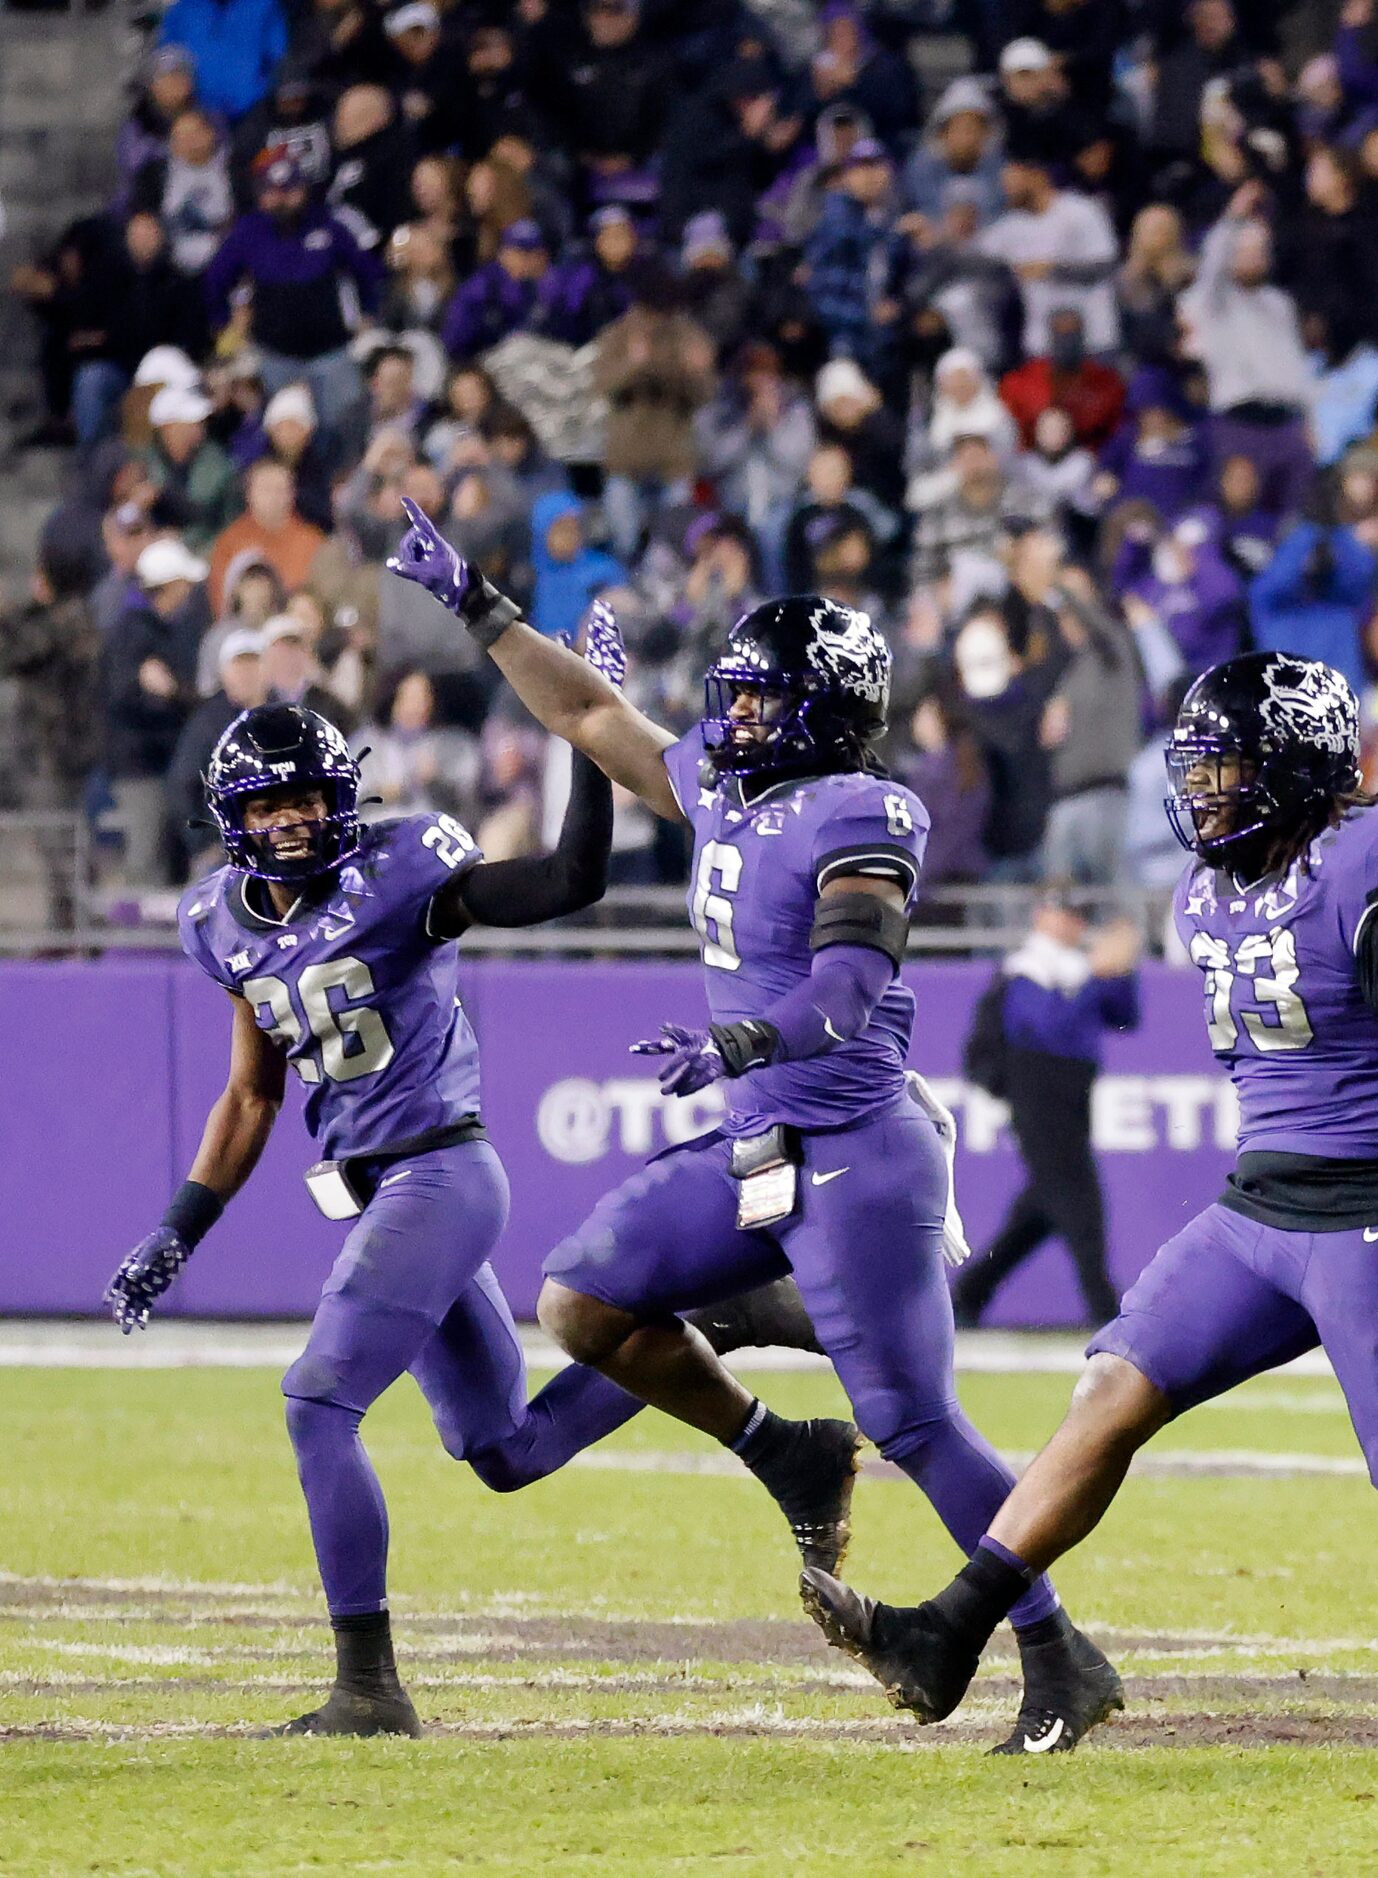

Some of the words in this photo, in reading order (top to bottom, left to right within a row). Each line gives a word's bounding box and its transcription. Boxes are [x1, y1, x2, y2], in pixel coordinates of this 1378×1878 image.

[421, 814, 474, 869] 26
[884, 795, 912, 836] 6
[693, 839, 743, 971] 6
[243, 956, 396, 1083] 26
